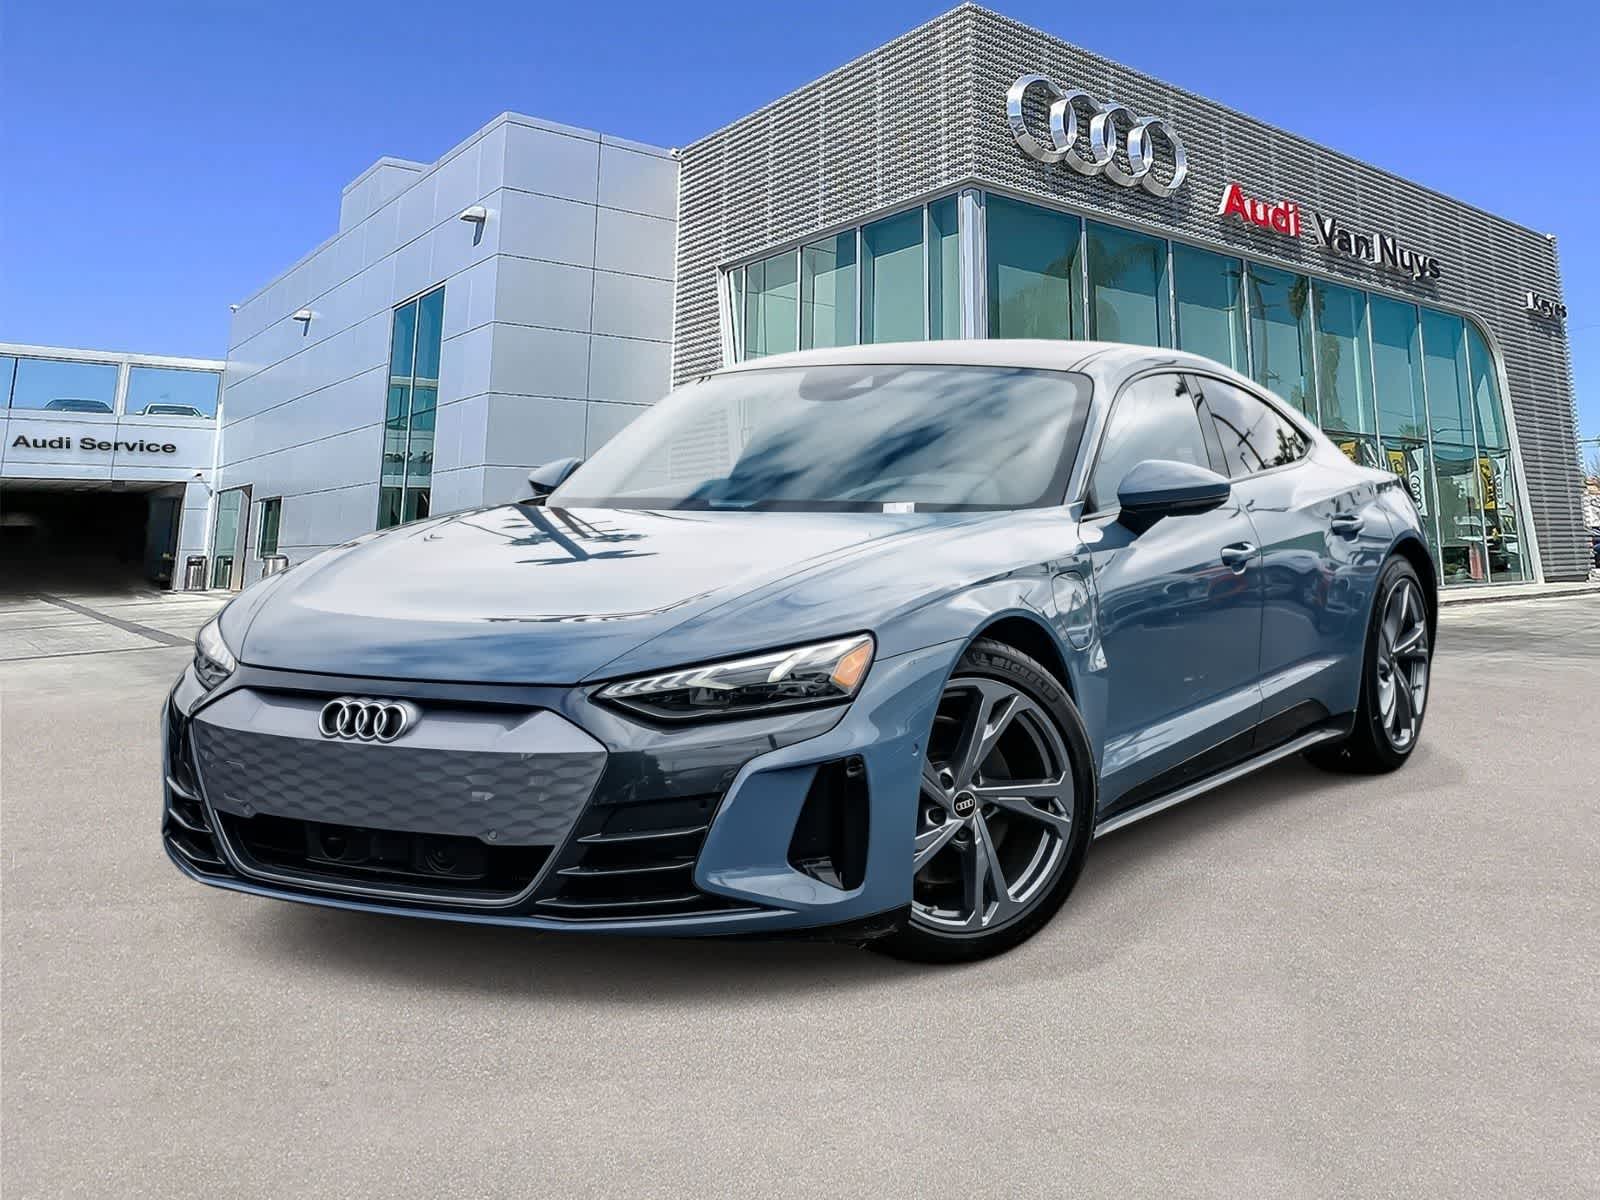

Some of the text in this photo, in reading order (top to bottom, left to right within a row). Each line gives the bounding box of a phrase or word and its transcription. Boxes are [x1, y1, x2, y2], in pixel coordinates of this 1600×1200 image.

[1217, 183, 1440, 280] Audi Van Nuys
[12, 434, 177, 453] Audi Service
